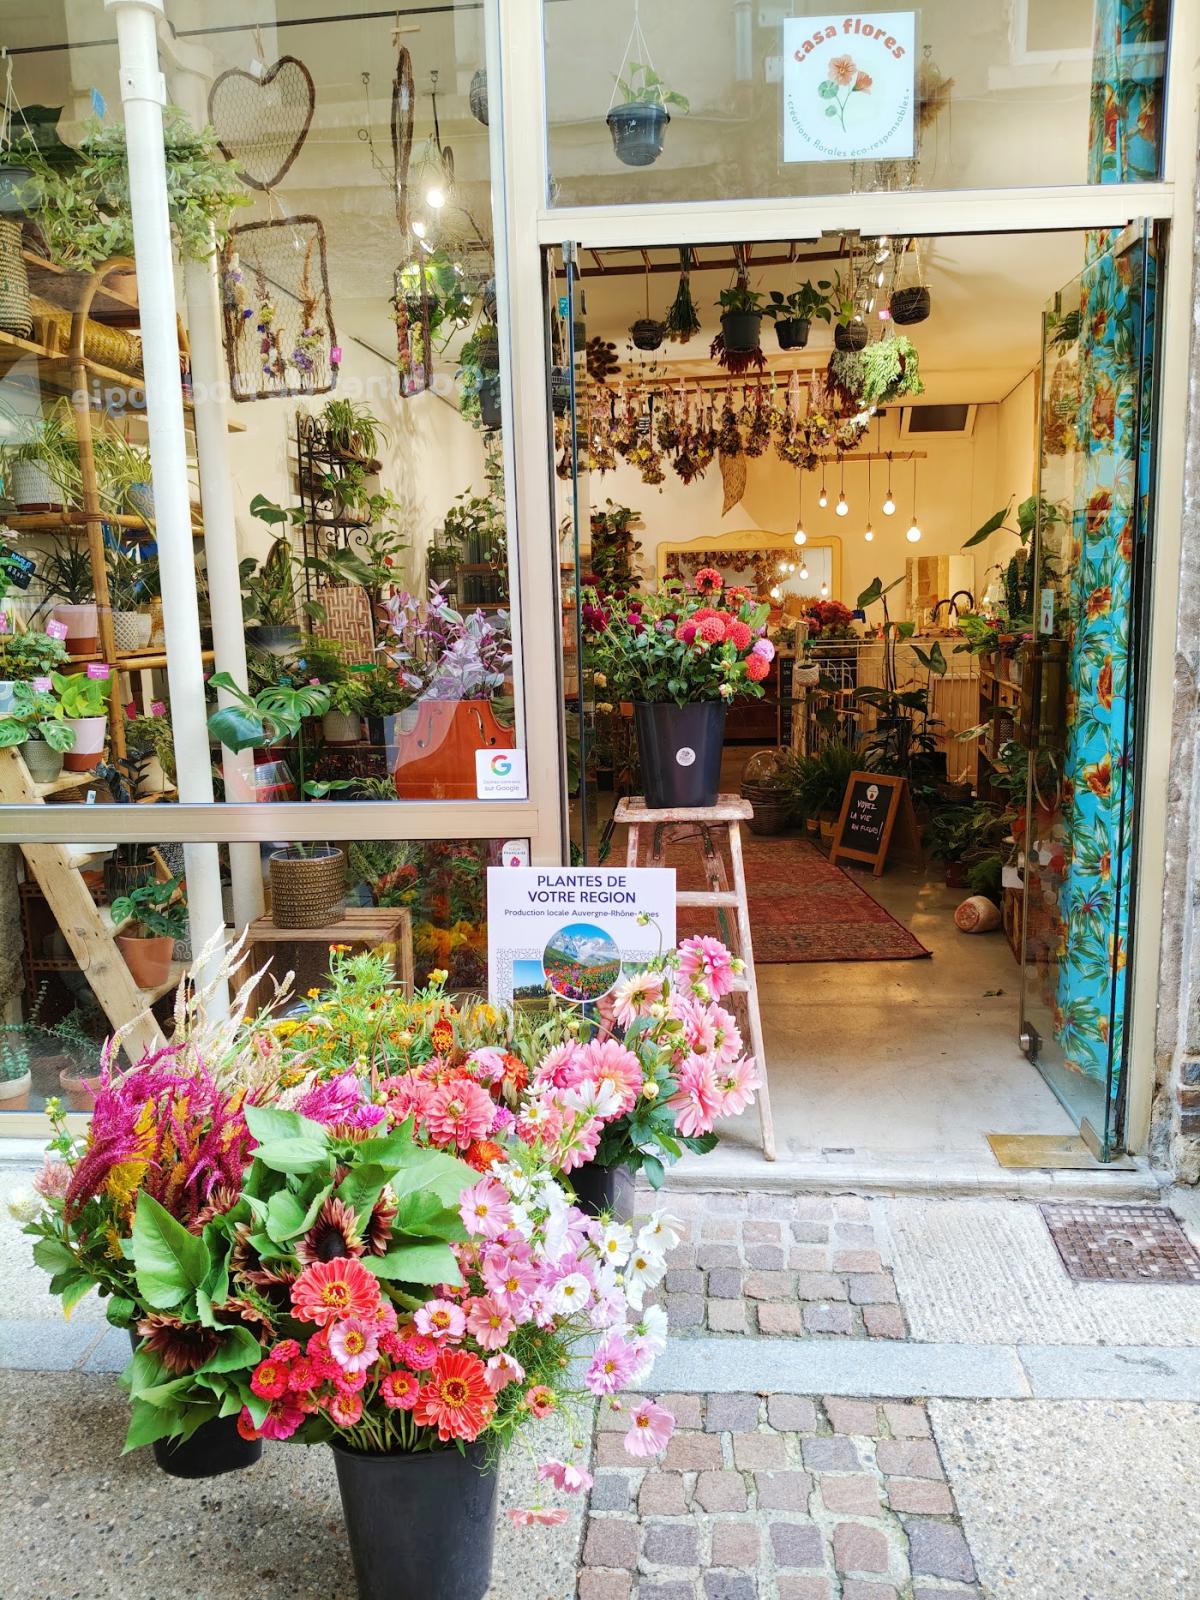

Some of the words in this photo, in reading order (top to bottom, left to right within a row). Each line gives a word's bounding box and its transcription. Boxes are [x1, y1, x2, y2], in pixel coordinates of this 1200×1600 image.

[793, 25, 837, 62] casa
[843, 18, 906, 59] flores
[787, 101, 811, 143] créations
[813, 138, 847, 157] florales
[850, 95, 910, 157] éco-responsables
[495, 784, 520, 793] Google
[536, 875, 603, 887] PLANTES
[607, 876, 627, 888] DE
[528, 890, 576, 903] VOTRE
[580, 891, 636, 904] REGION
[504, 908, 545, 917] Production
[546, 909, 570, 917] locale
